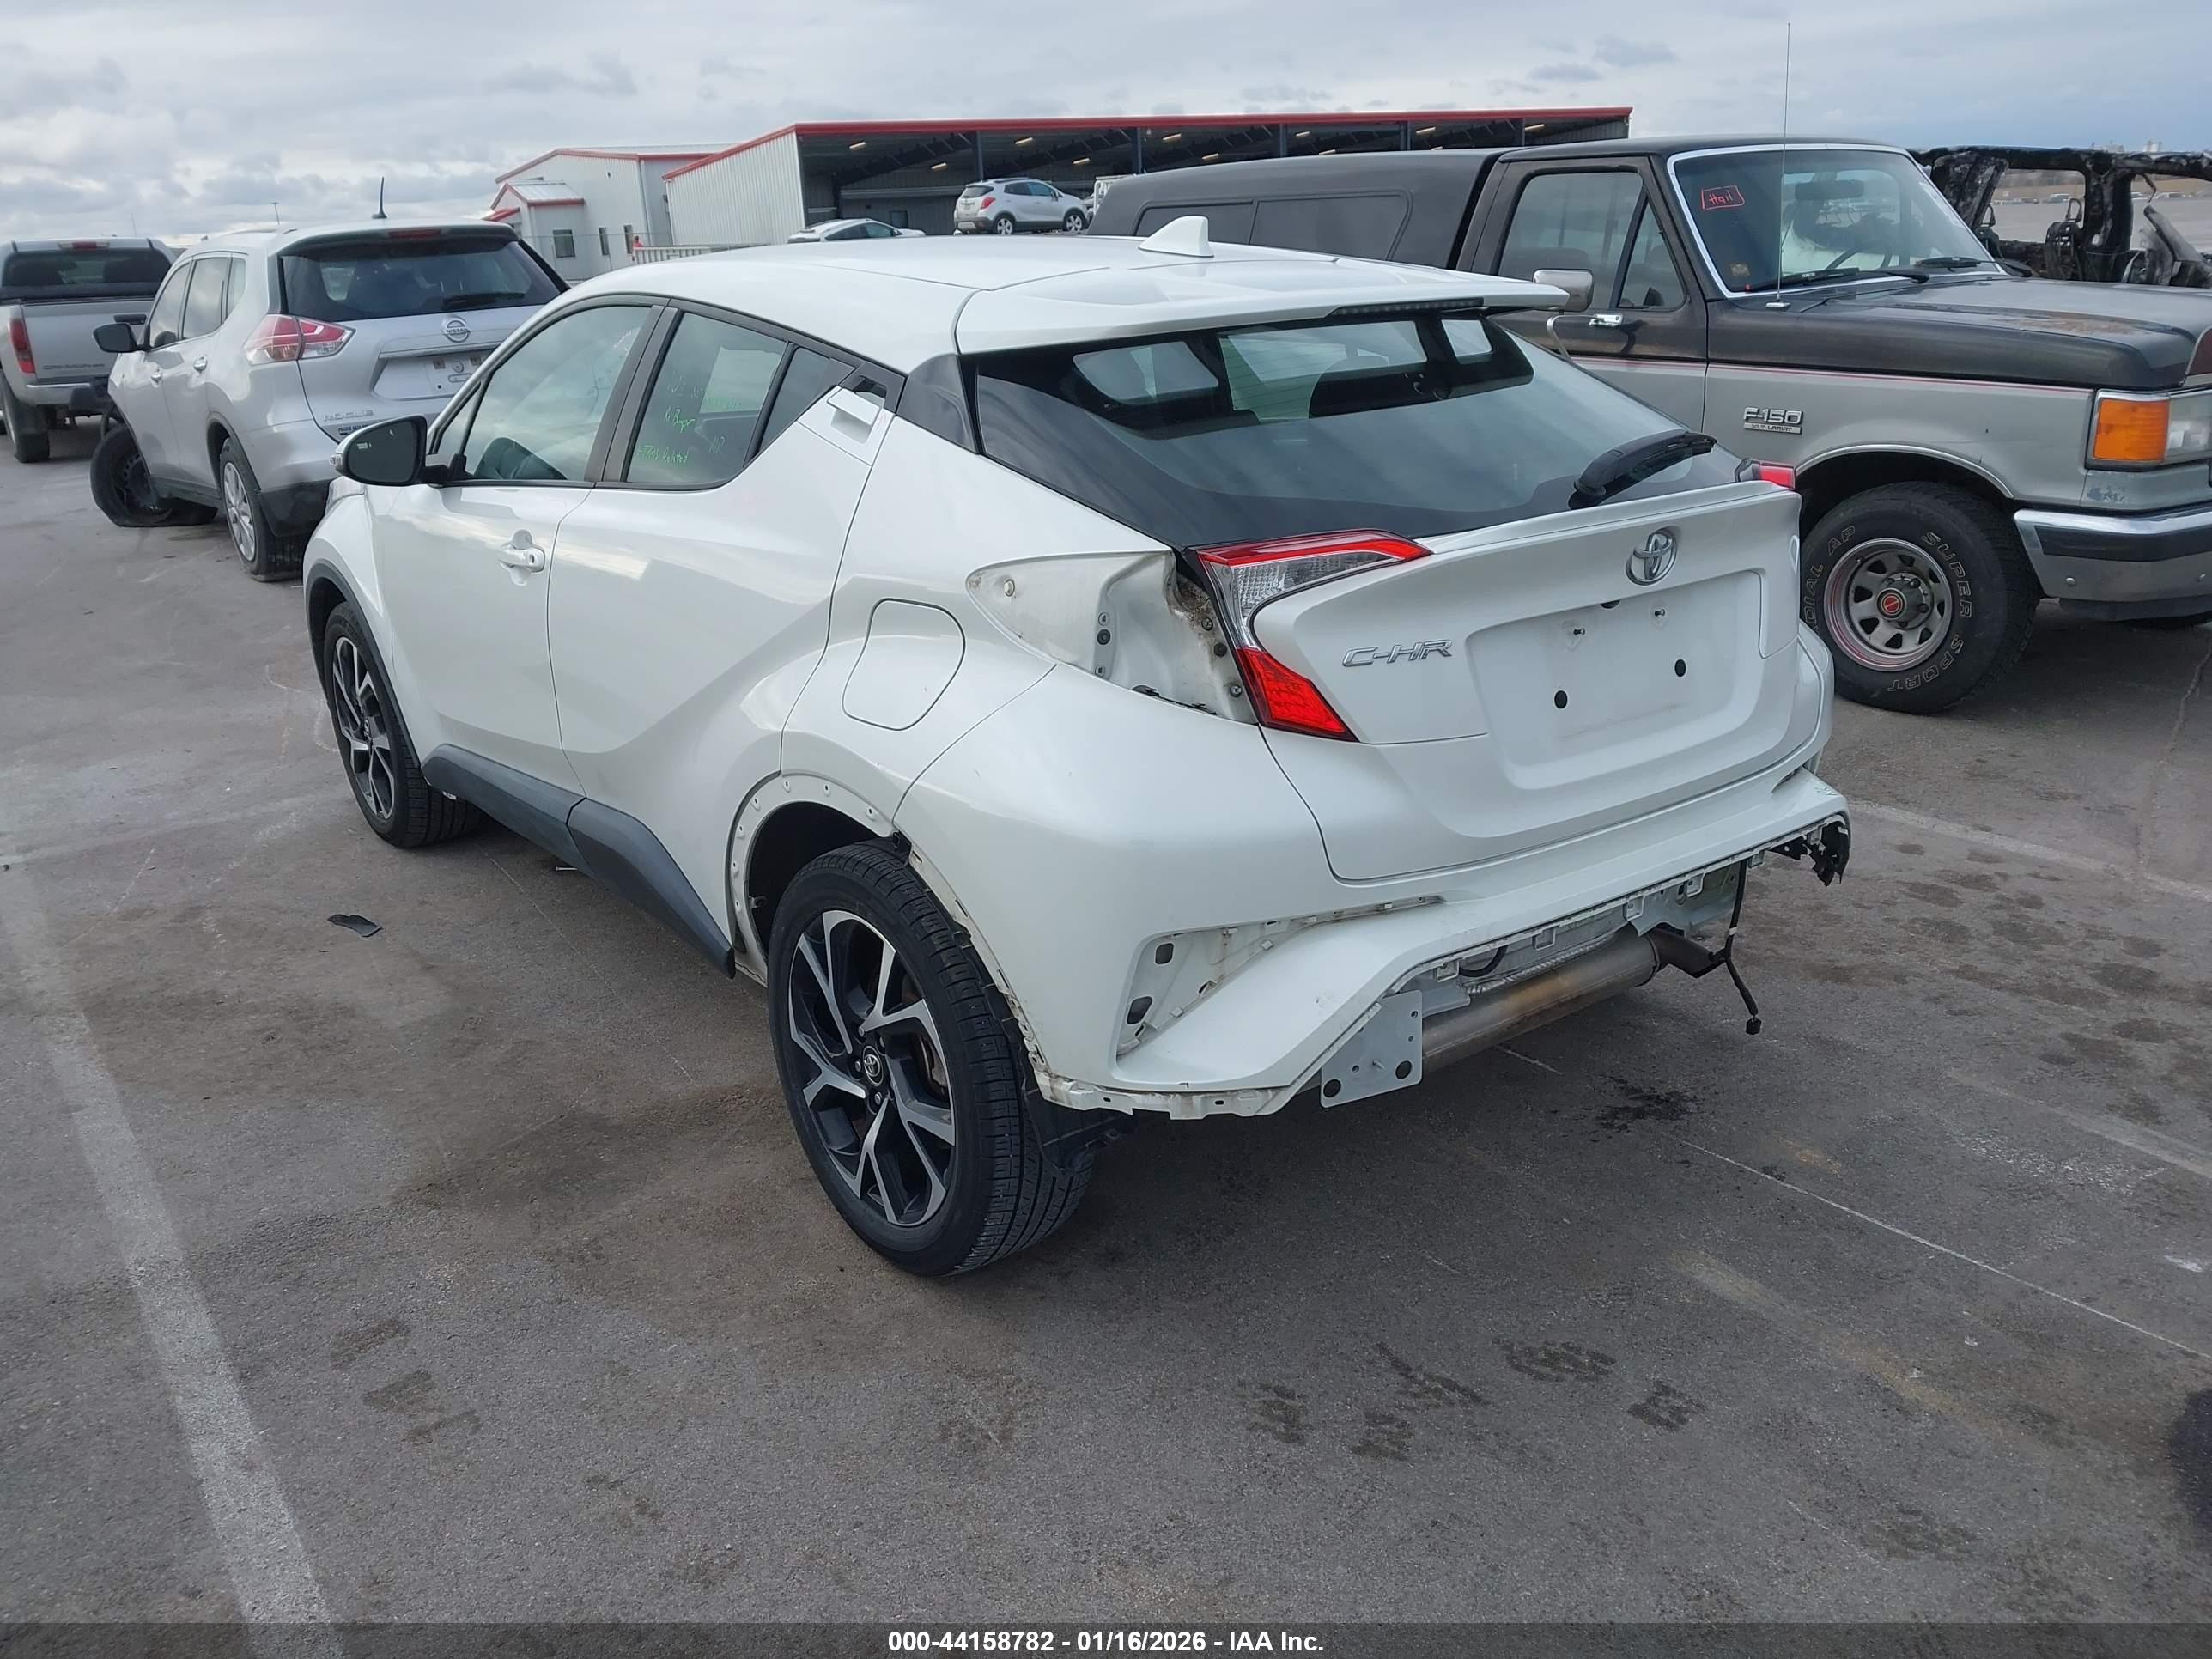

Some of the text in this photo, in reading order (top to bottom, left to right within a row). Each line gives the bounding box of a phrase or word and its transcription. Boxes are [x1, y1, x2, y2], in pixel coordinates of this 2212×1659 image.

[1709, 190, 1734, 205] Hail
[324, 410, 374, 422] ROGUE
[1743, 407, 1802, 424] F-150
[1804, 526, 1856, 629] DIAL AP
[1887, 532, 1972, 692] SUPER SPORT
[1342, 640, 1453, 667] C-HR
